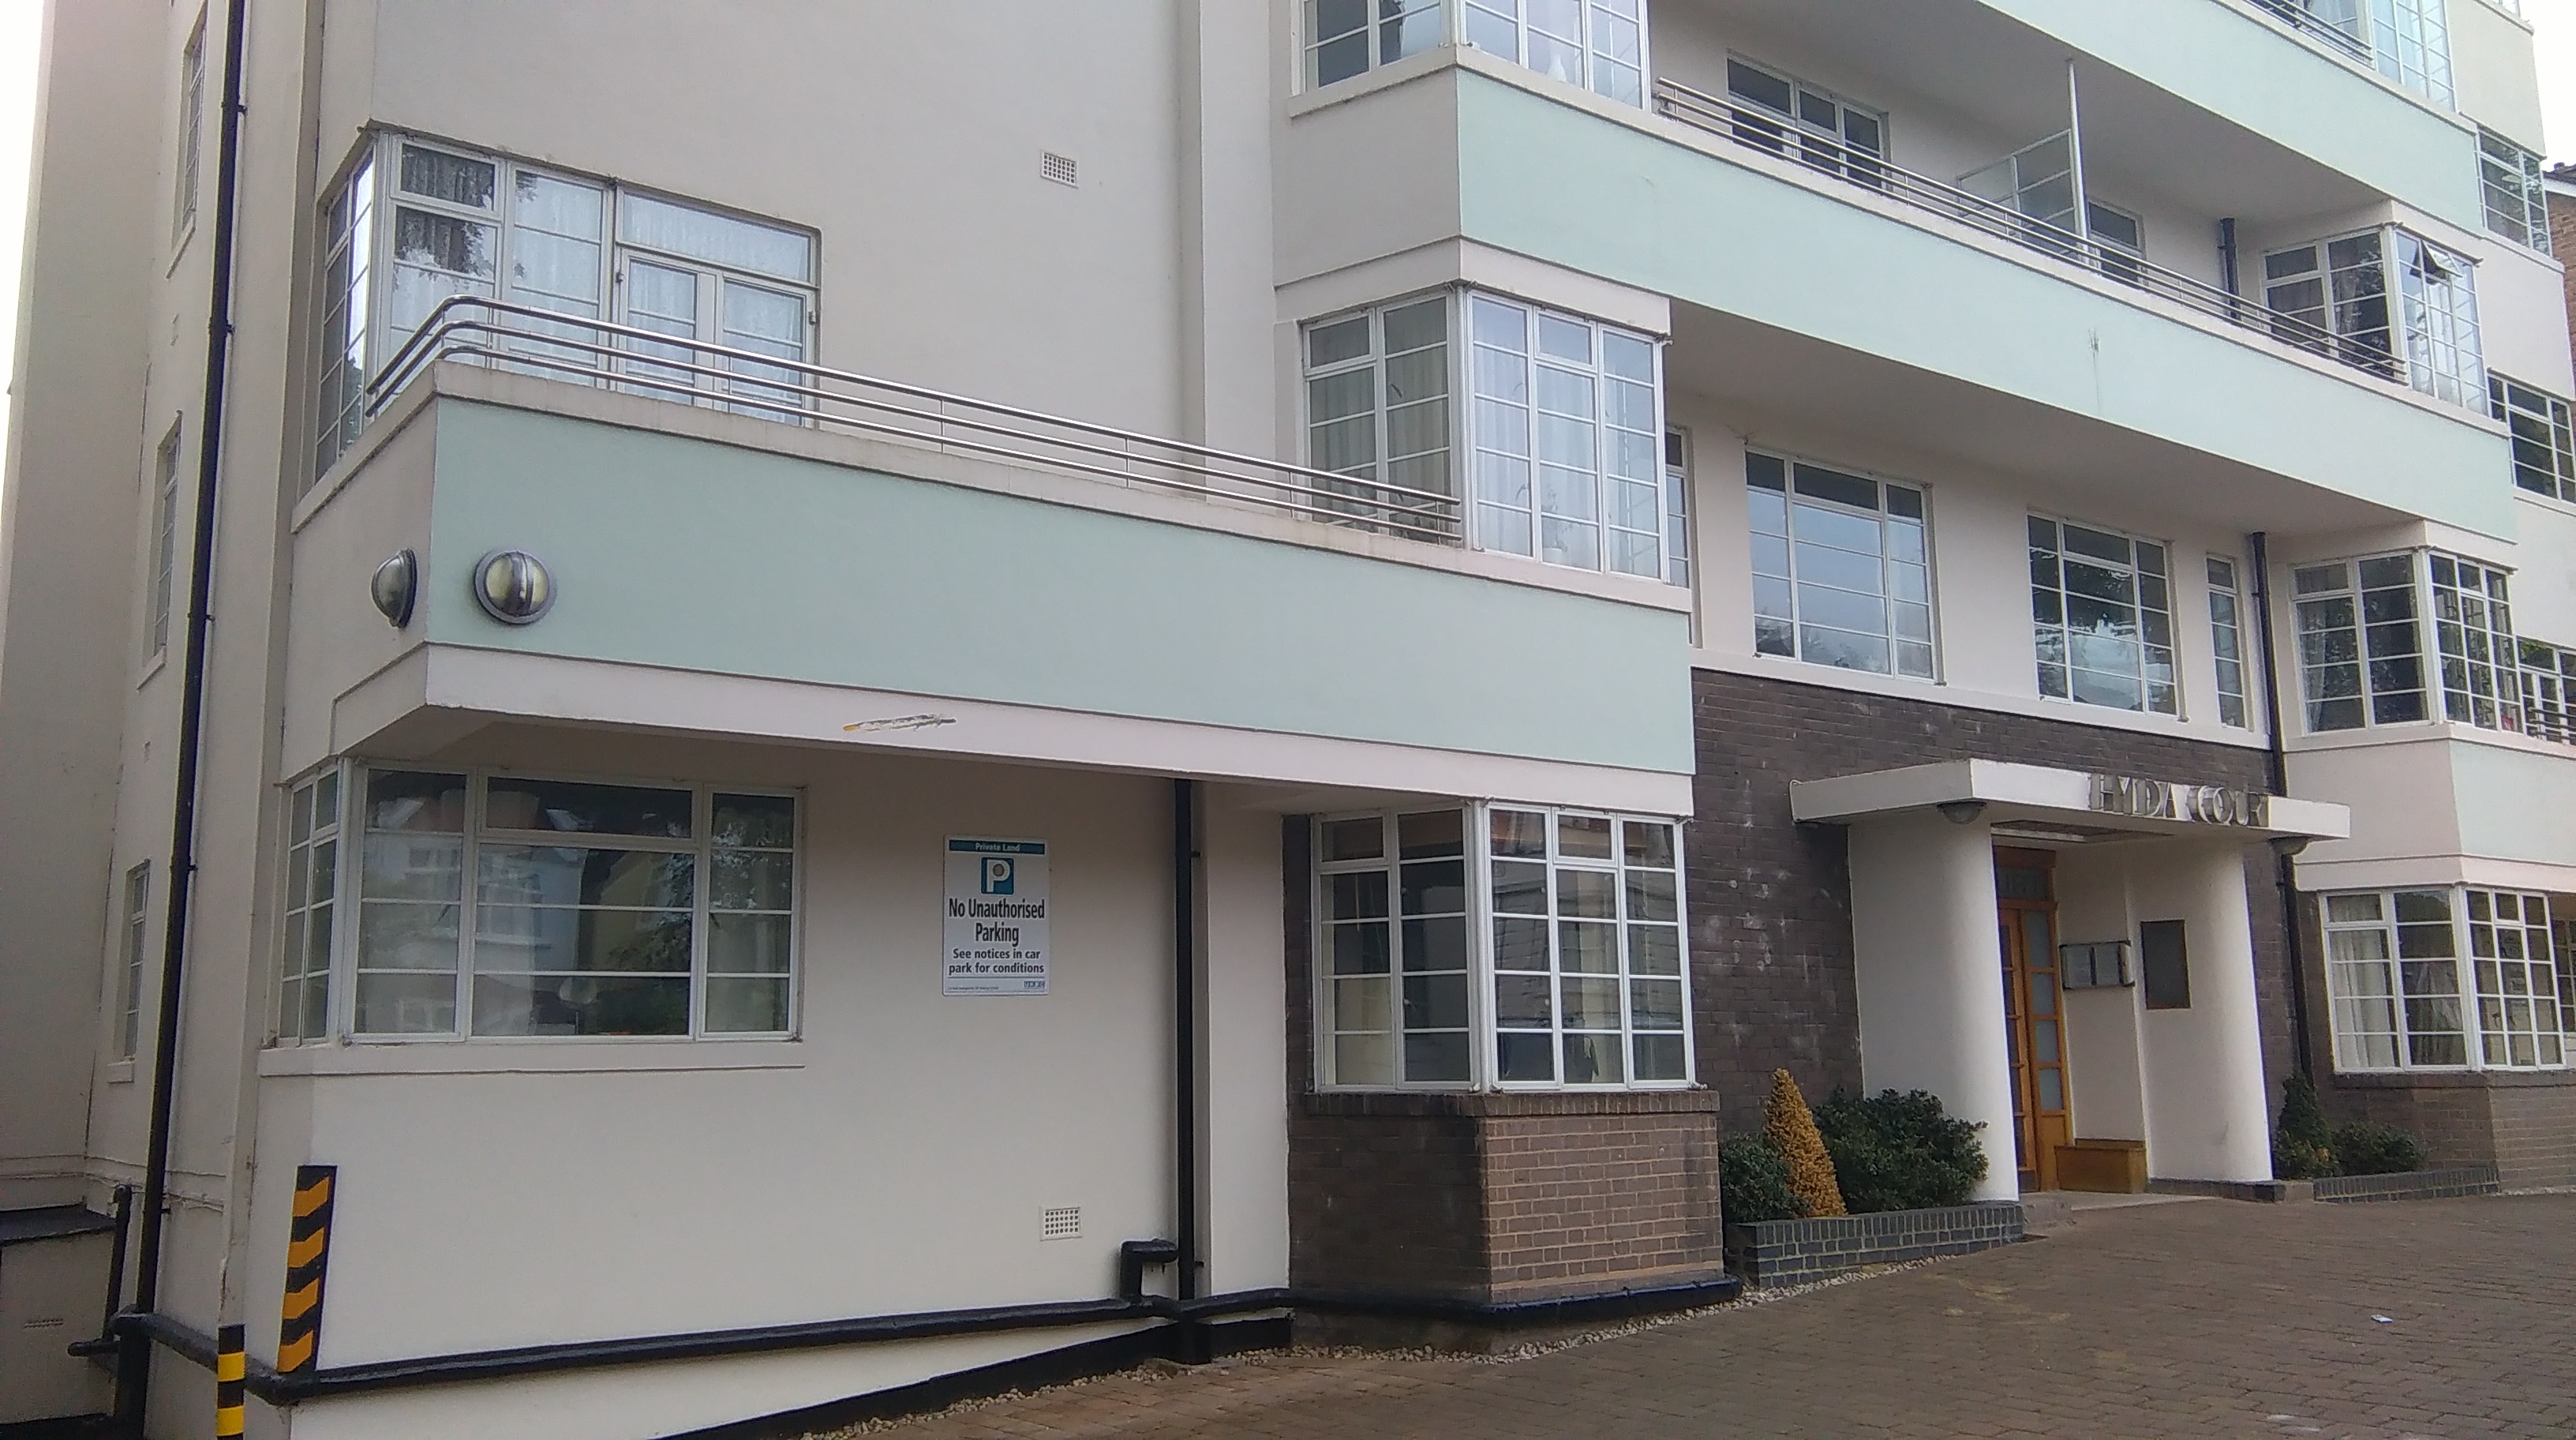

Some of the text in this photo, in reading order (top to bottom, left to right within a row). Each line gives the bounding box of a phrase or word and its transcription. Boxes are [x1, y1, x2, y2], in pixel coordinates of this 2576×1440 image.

[975, 842, 1001, 851] Private
[986, 858, 1011, 893] P
[949, 898, 1045, 918] No Unauthorised
[975, 921, 1020, 947] Parking
[953, 948, 1041, 959] See notices in car
[948, 962, 1044, 976] park for conditions
